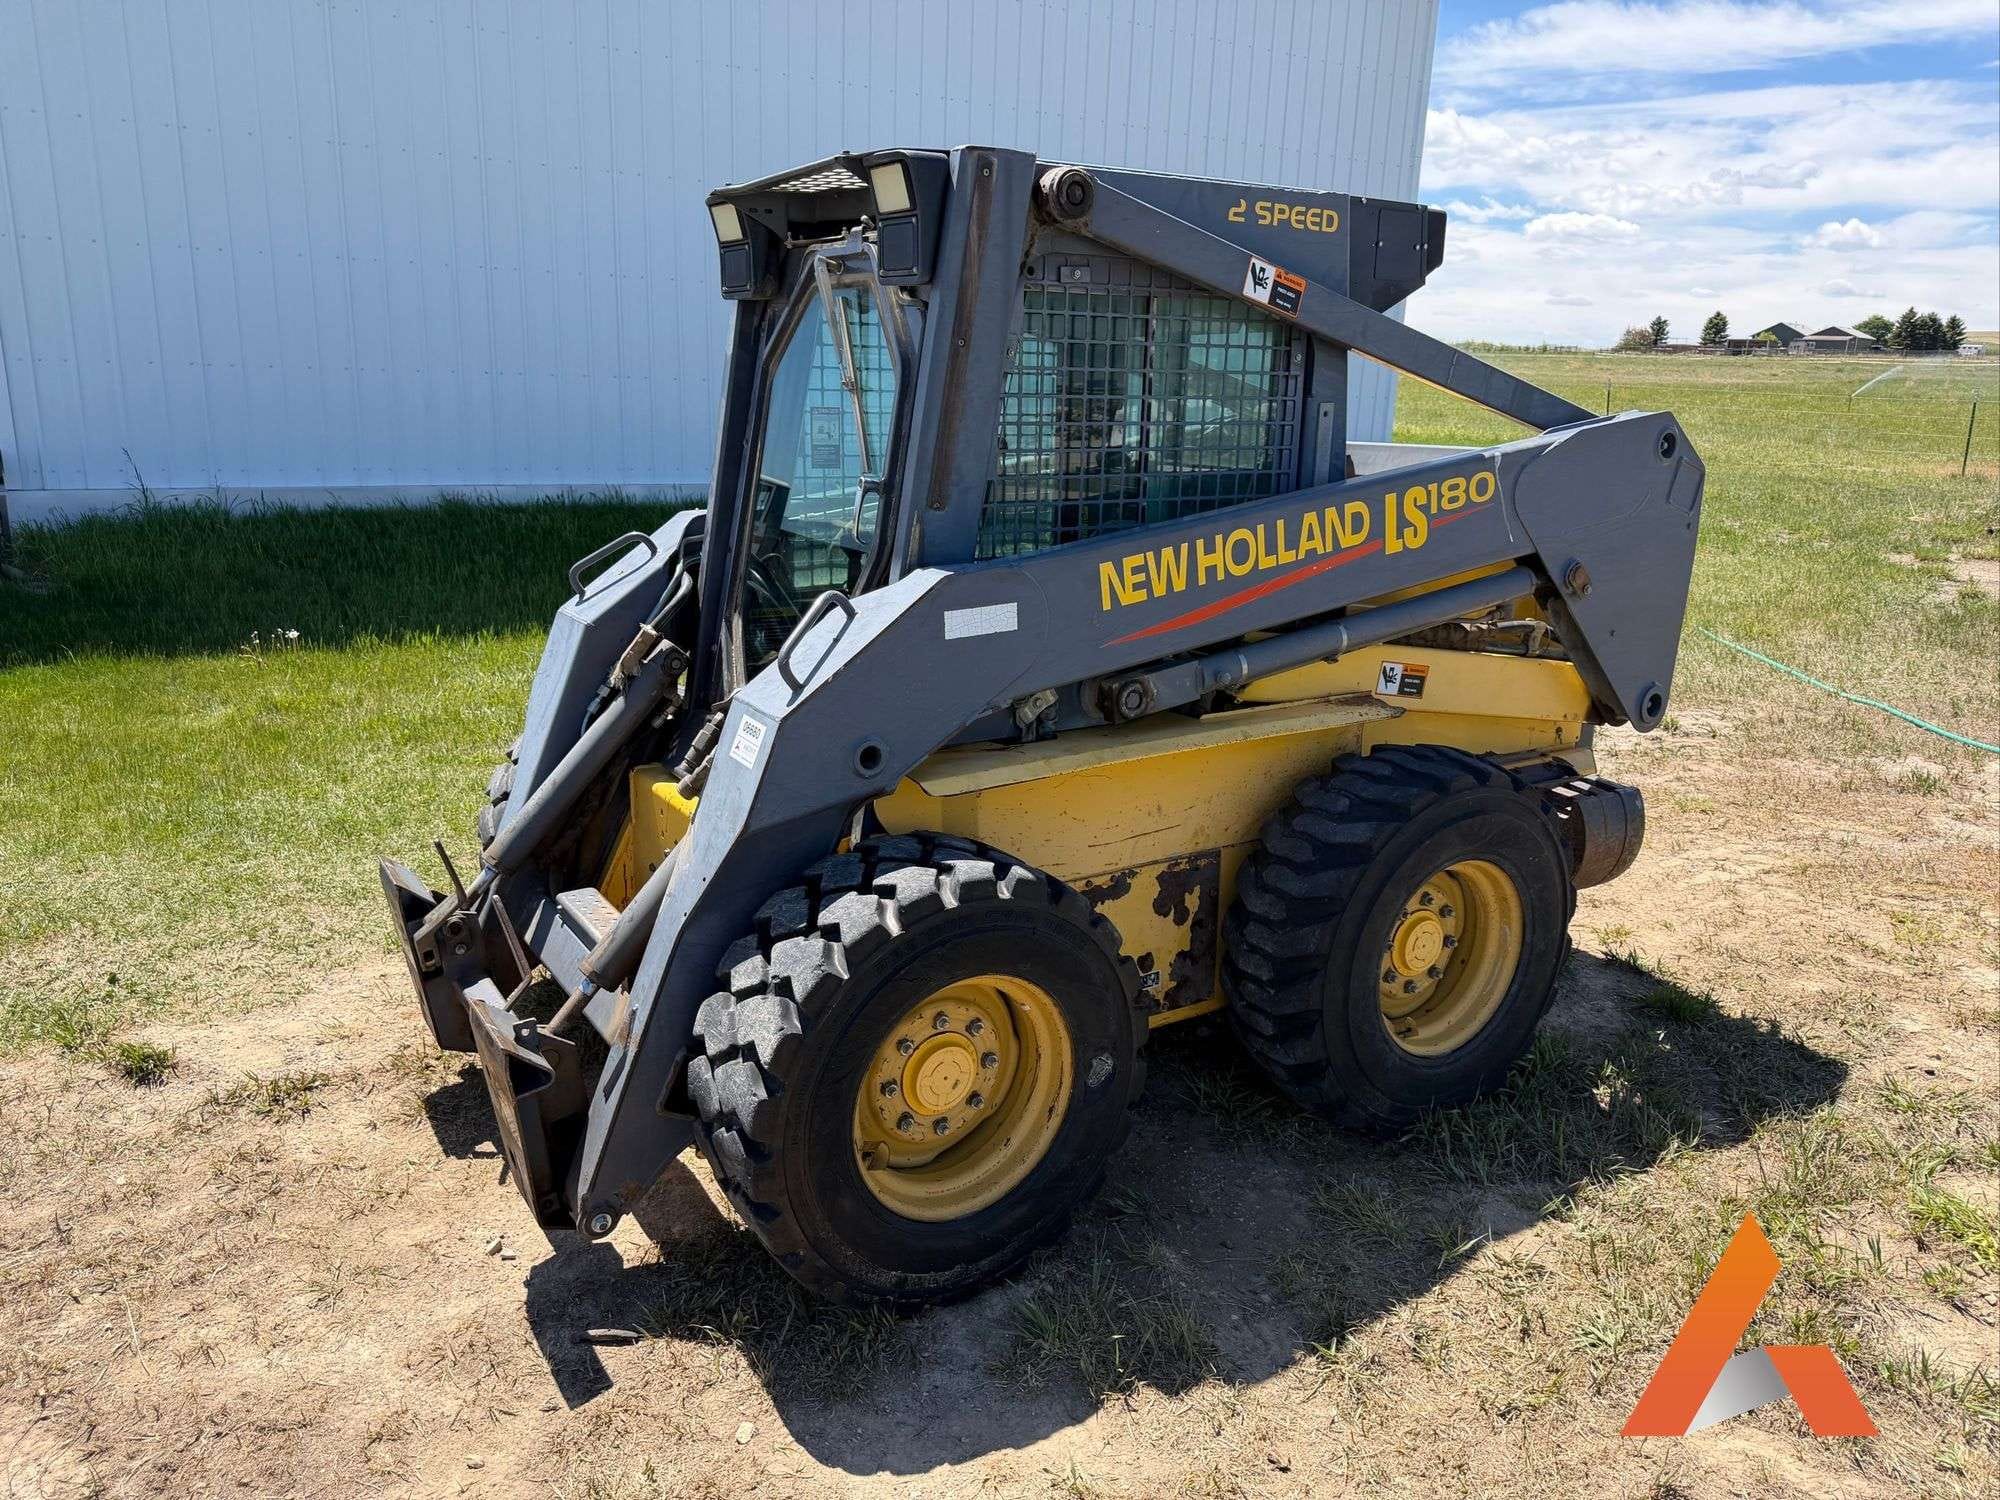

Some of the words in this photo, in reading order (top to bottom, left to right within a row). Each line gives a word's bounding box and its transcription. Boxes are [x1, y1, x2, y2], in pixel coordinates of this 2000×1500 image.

[1228, 198, 1246, 223] 2
[1254, 201, 1339, 233] SPEED
[1099, 543, 1188, 611] NEW
[1196, 501, 1371, 585] HOLLAND
